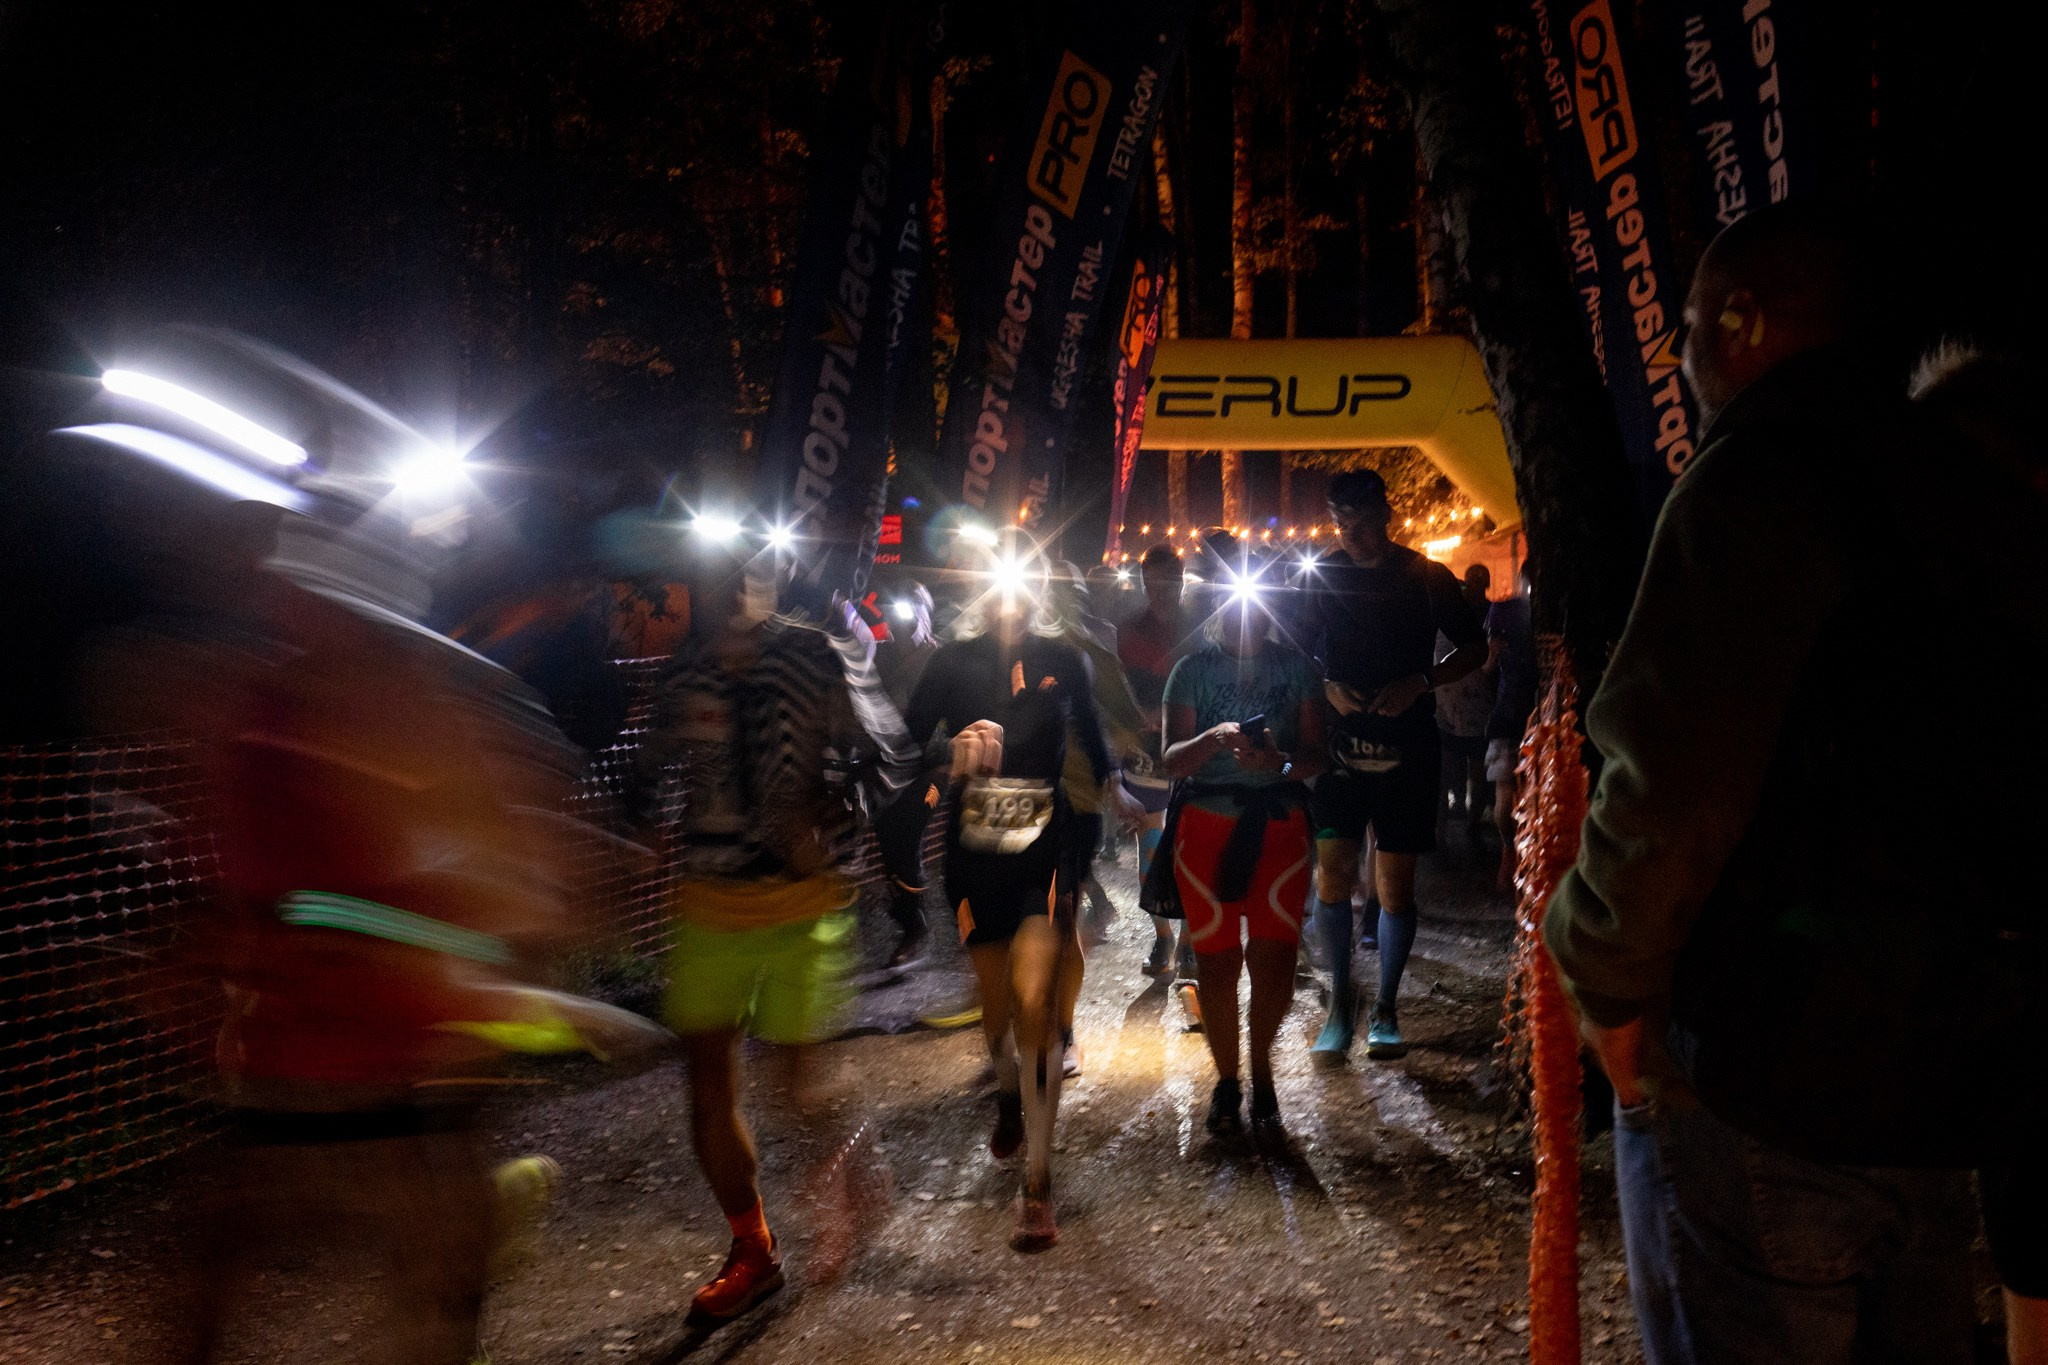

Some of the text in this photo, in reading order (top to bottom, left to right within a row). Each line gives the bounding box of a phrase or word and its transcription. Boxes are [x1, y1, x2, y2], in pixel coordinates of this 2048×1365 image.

[1036, 70, 1099, 203] PRO
[1071, 239, 1104, 302] TRAIL
[1145, 374, 1411, 417] ERUP
